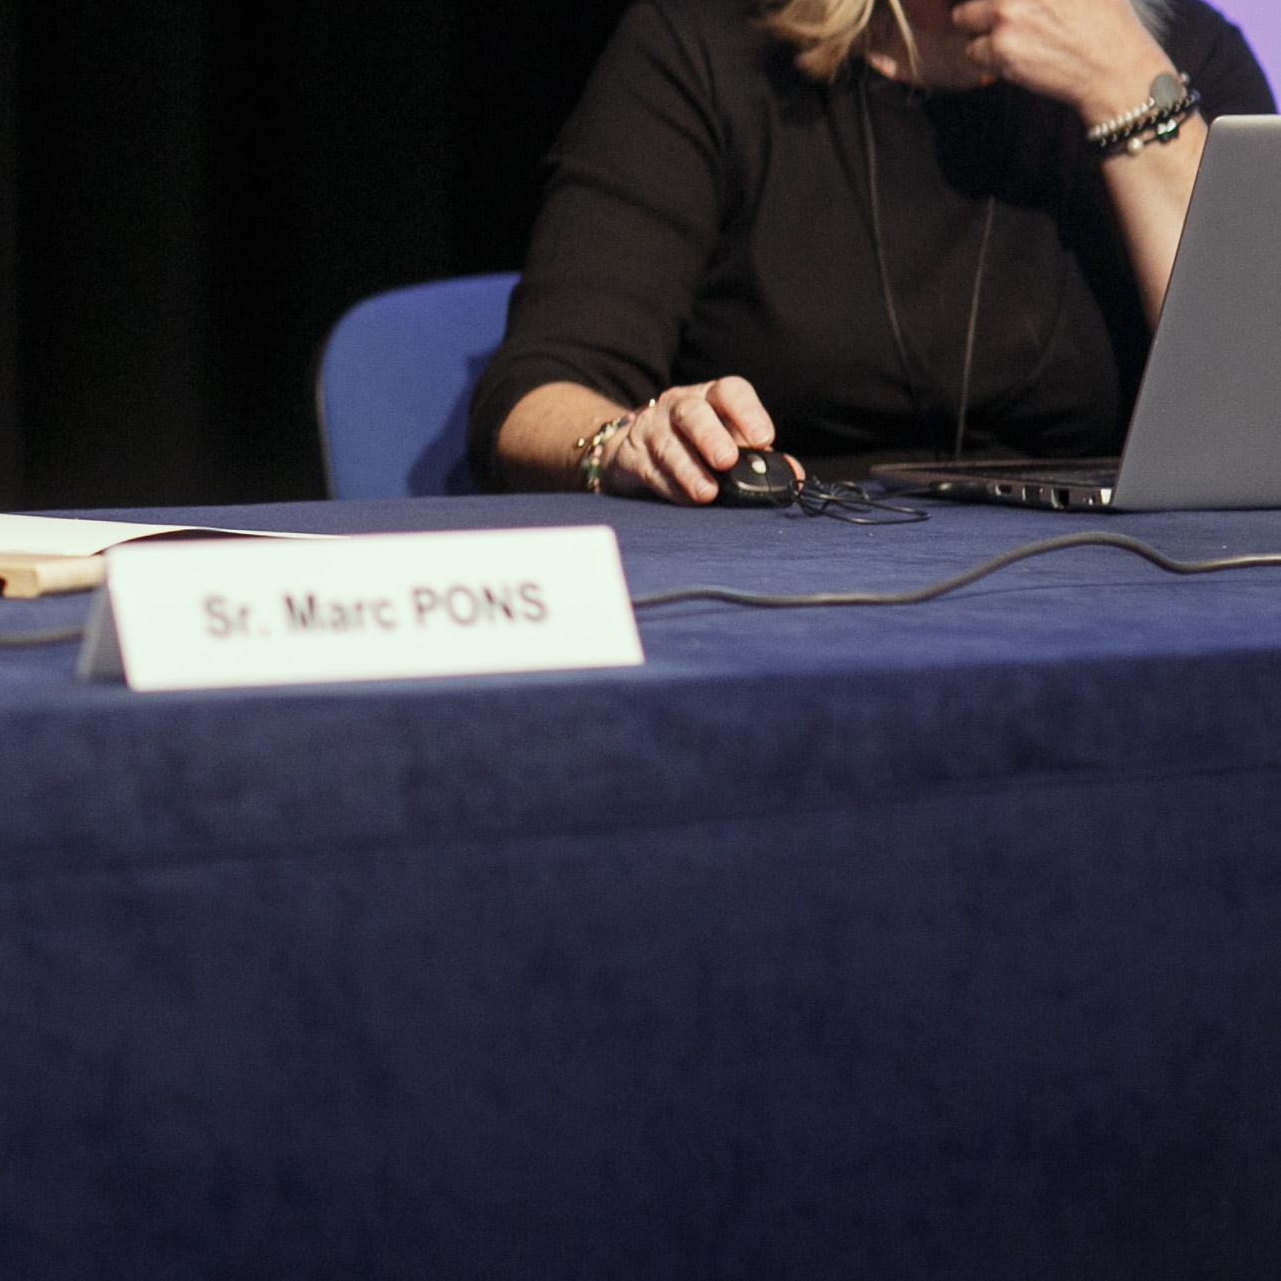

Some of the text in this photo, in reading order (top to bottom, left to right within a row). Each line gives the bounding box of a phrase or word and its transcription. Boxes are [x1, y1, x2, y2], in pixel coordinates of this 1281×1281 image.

[202, 580, 548, 639] Sr. Marc PONS
